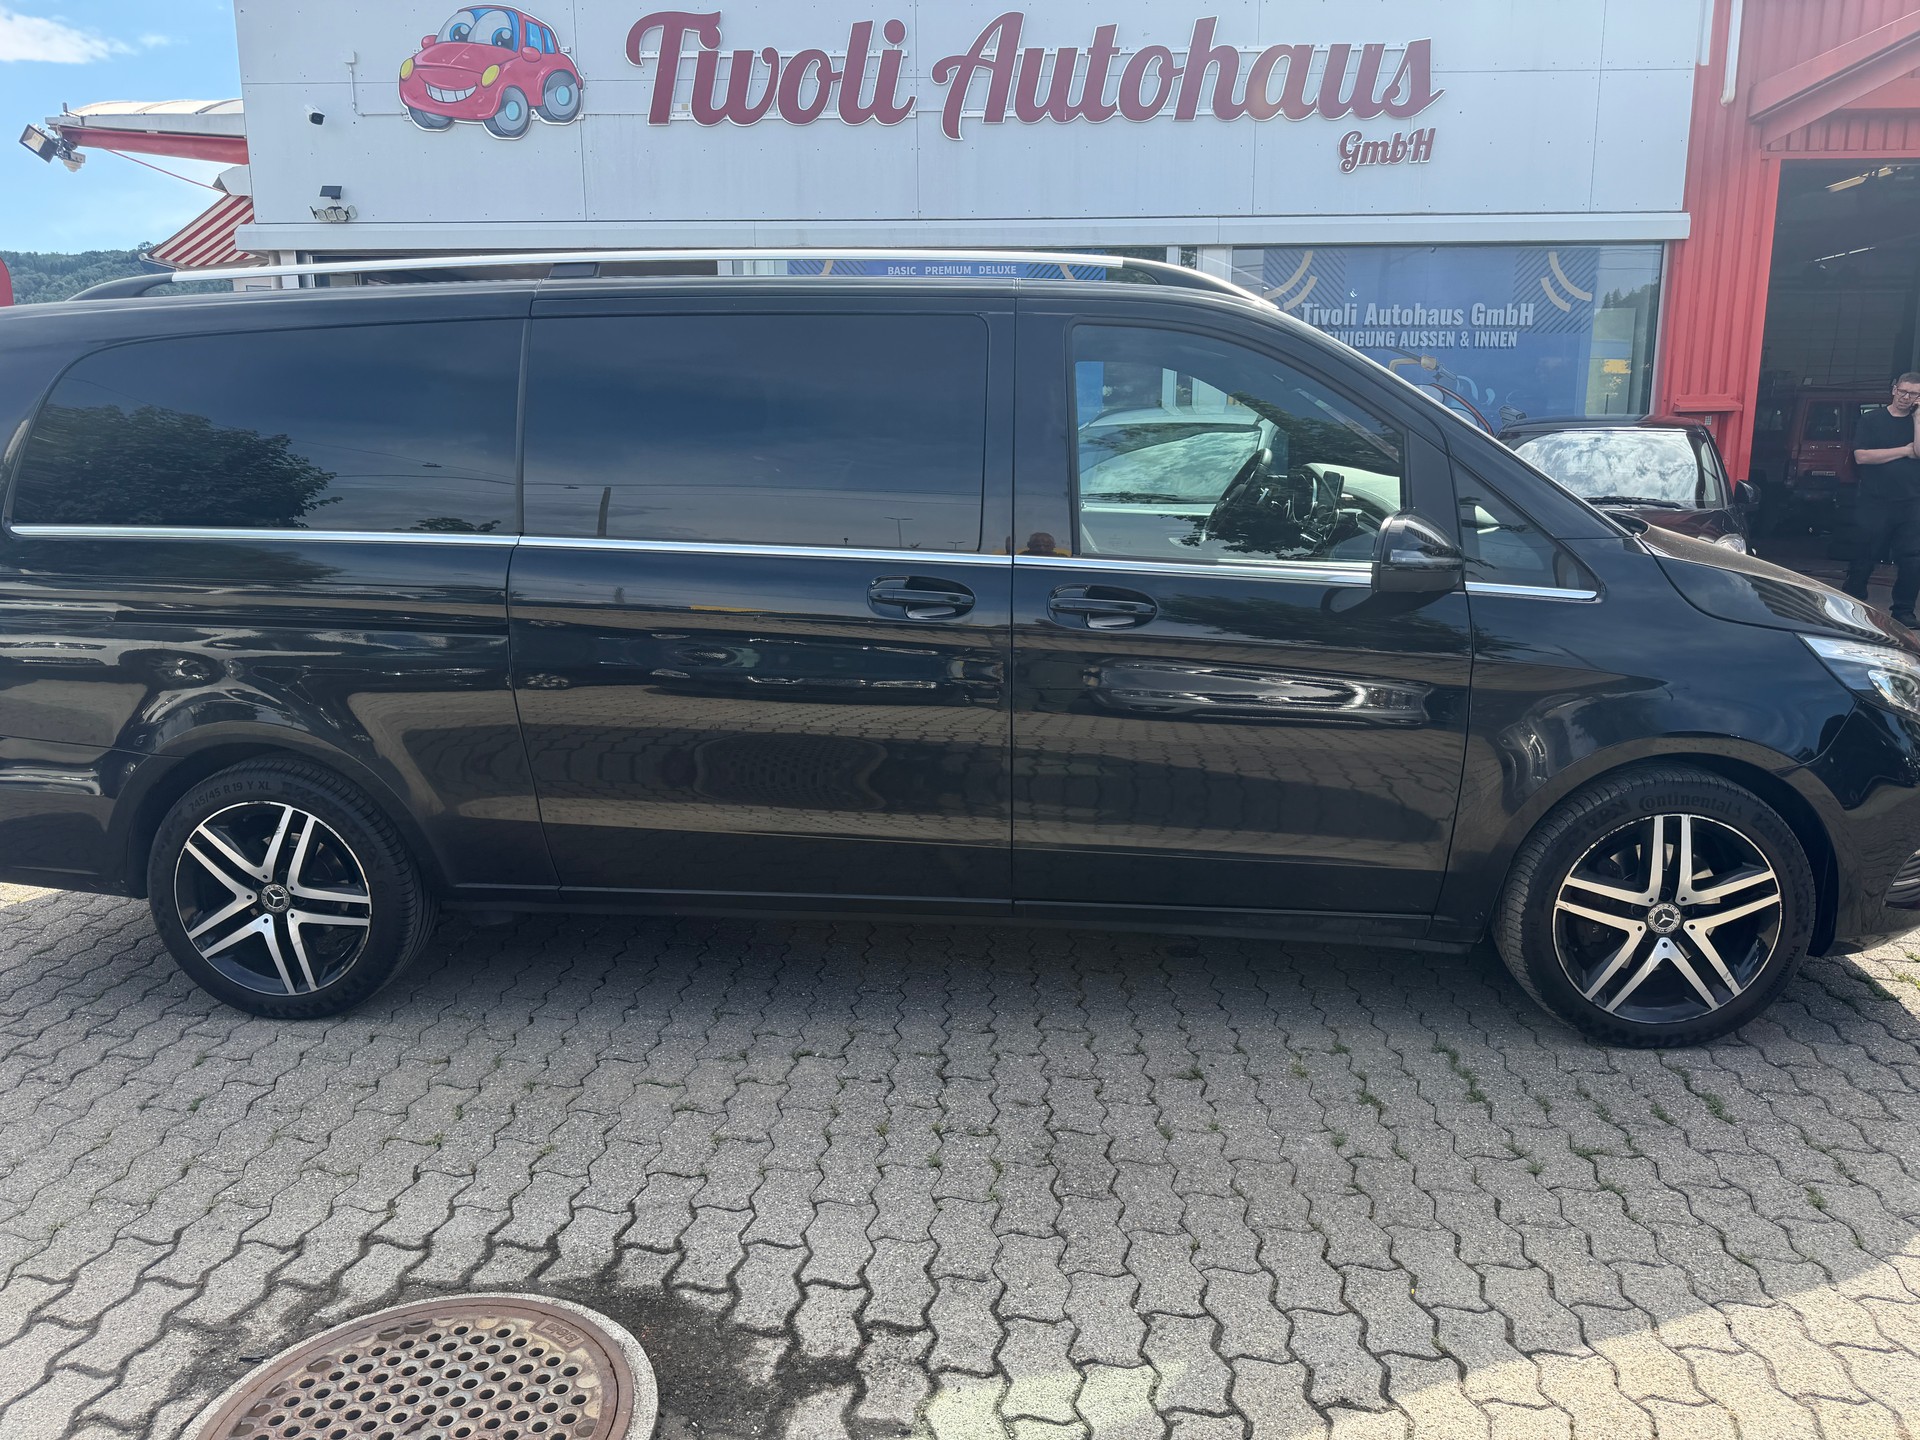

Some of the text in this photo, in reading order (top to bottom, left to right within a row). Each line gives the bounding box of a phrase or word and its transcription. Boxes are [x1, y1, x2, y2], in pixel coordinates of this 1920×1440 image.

[625, 10, 1445, 140] Tivoli Autohaus
[1338, 128, 1436, 173] GmbH
[887, 265, 1017, 275] BASIC PREMIUM DELUXE
[1301, 302, 1535, 326] Tivoli Autohaus GmbH
[1327, 331, 1518, 347] INIGUNG AUSSEN & INNEN
[223, 784, 232, 794] R
[232, 782, 243, 792] 19
[1638, 792, 1733, 814] Continental
